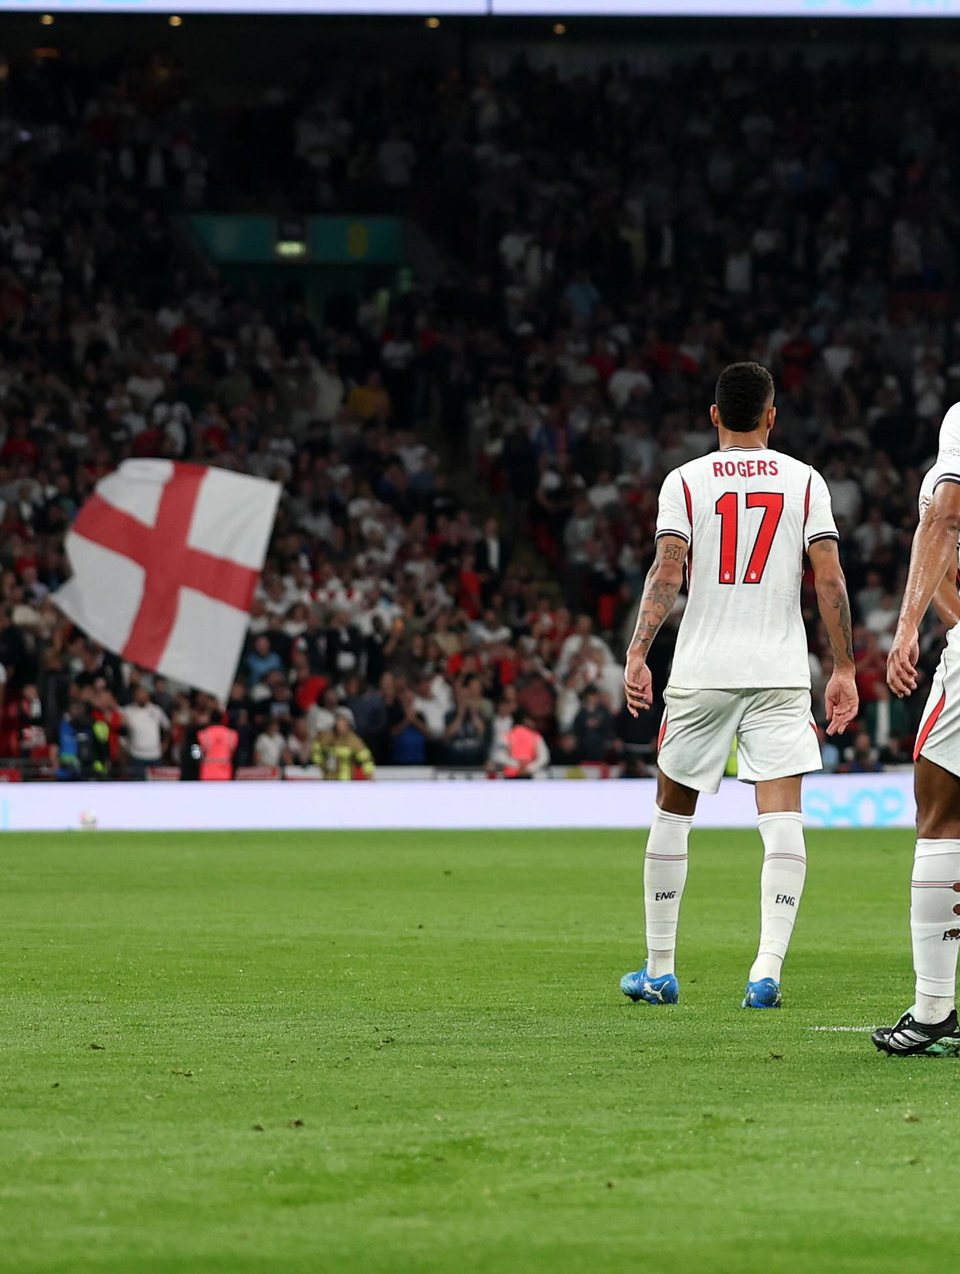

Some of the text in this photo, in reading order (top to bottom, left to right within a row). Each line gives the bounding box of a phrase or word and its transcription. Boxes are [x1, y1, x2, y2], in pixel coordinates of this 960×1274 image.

[713, 460, 779, 477] ROGERS
[715, 492, 784, 584] 17
[805, 787, 905, 828] SHOP
[655, 891, 676, 901] ENG
[775, 894, 796, 906] ENG
